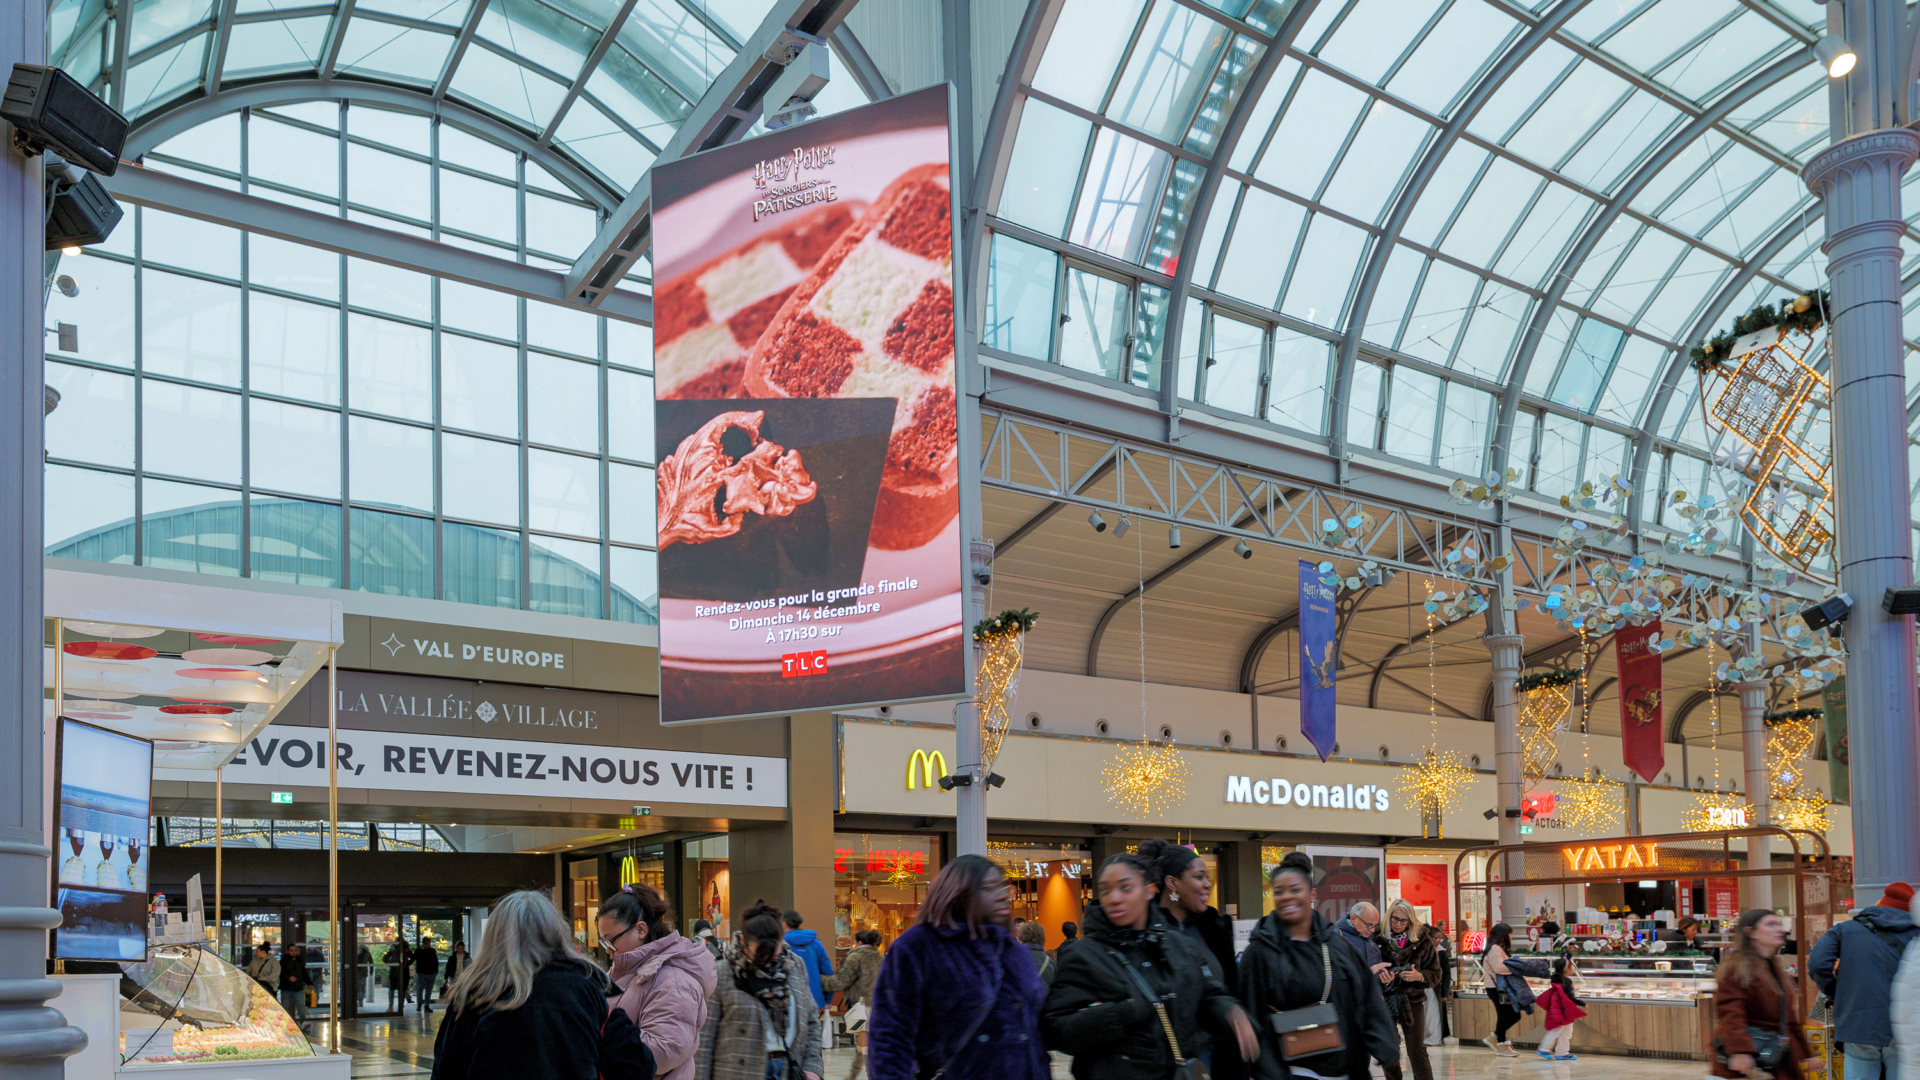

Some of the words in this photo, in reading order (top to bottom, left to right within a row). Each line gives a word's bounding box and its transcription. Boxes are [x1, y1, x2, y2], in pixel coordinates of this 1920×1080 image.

[752, 156, 793, 189] Harry
[793, 145, 836, 182] Potter
[753, 184, 838, 222] PÂTISSERIE
[695, 599, 776, 618] Rendez-vous
[778, 595, 809, 610] pour
[811, 590, 825, 602] la
[826, 583, 876, 602] grande
[878, 577, 919, 594] finale
[729, 611, 794, 631] Dimanche
[796, 609, 811, 622] 14
[813, 602, 881, 620] décembre
[766, 628, 776, 644] À
[779, 625, 819, 642] 17h30
[821, 625, 843, 637] sur
[413, 638, 454, 658] VAL
[463, 643, 564, 669] D'EUROPE
[783, 653, 827, 675] TLC
[337, 690, 370, 713] LA
[378, 693, 473, 720] VALLÉE
[501, 703, 598, 729] VILLAGE
[383, 744, 659, 786] REVENEZ-NOUS
[671, 762, 733, 790] VITE
[746, 767, 753, 791] !
[1226, 775, 1389, 811] McDonald's
[1562, 843, 1658, 871] YATAI
